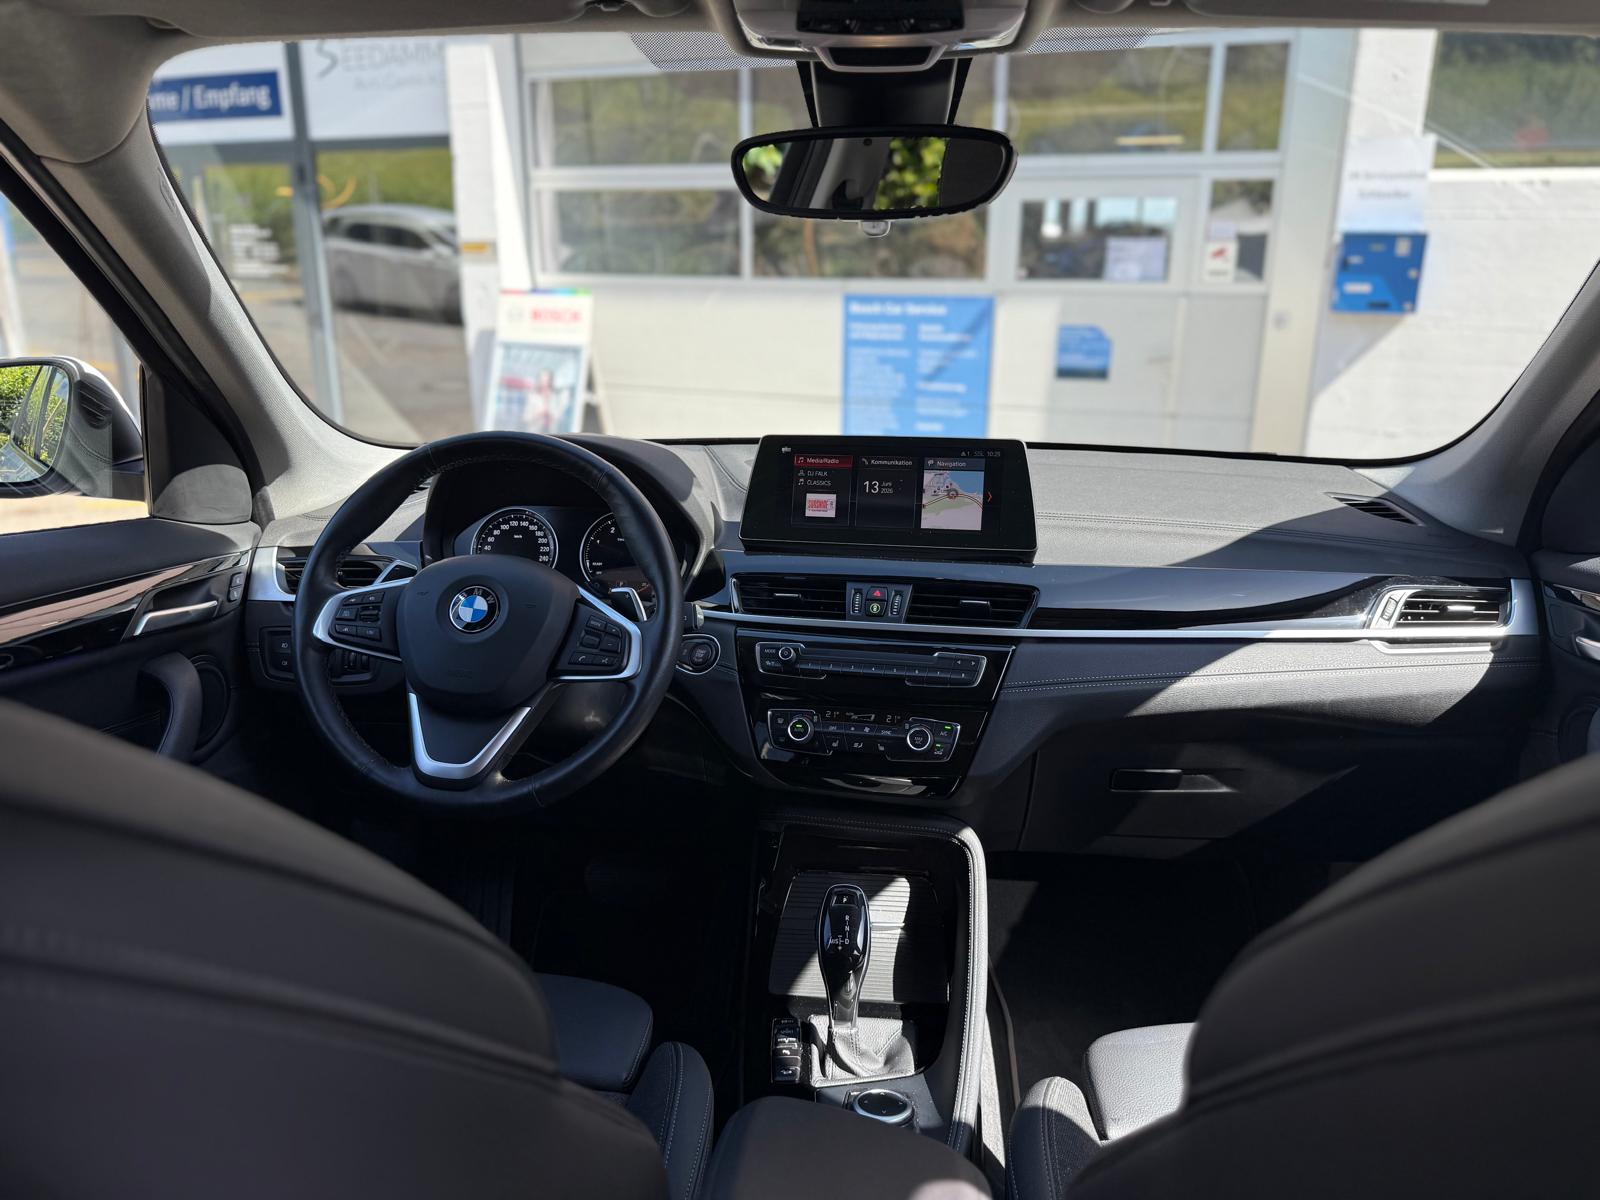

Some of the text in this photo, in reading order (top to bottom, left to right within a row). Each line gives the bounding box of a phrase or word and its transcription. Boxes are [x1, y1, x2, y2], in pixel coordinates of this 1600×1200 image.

[192, 81, 272, 111] Empfang
[870, 458, 913, 467] Kommunikation
[937, 460, 967, 468] Navigation
[863, 480, 879, 494] 13
[500, 523, 510, 531] 100
[538, 554, 549, 562] 240
